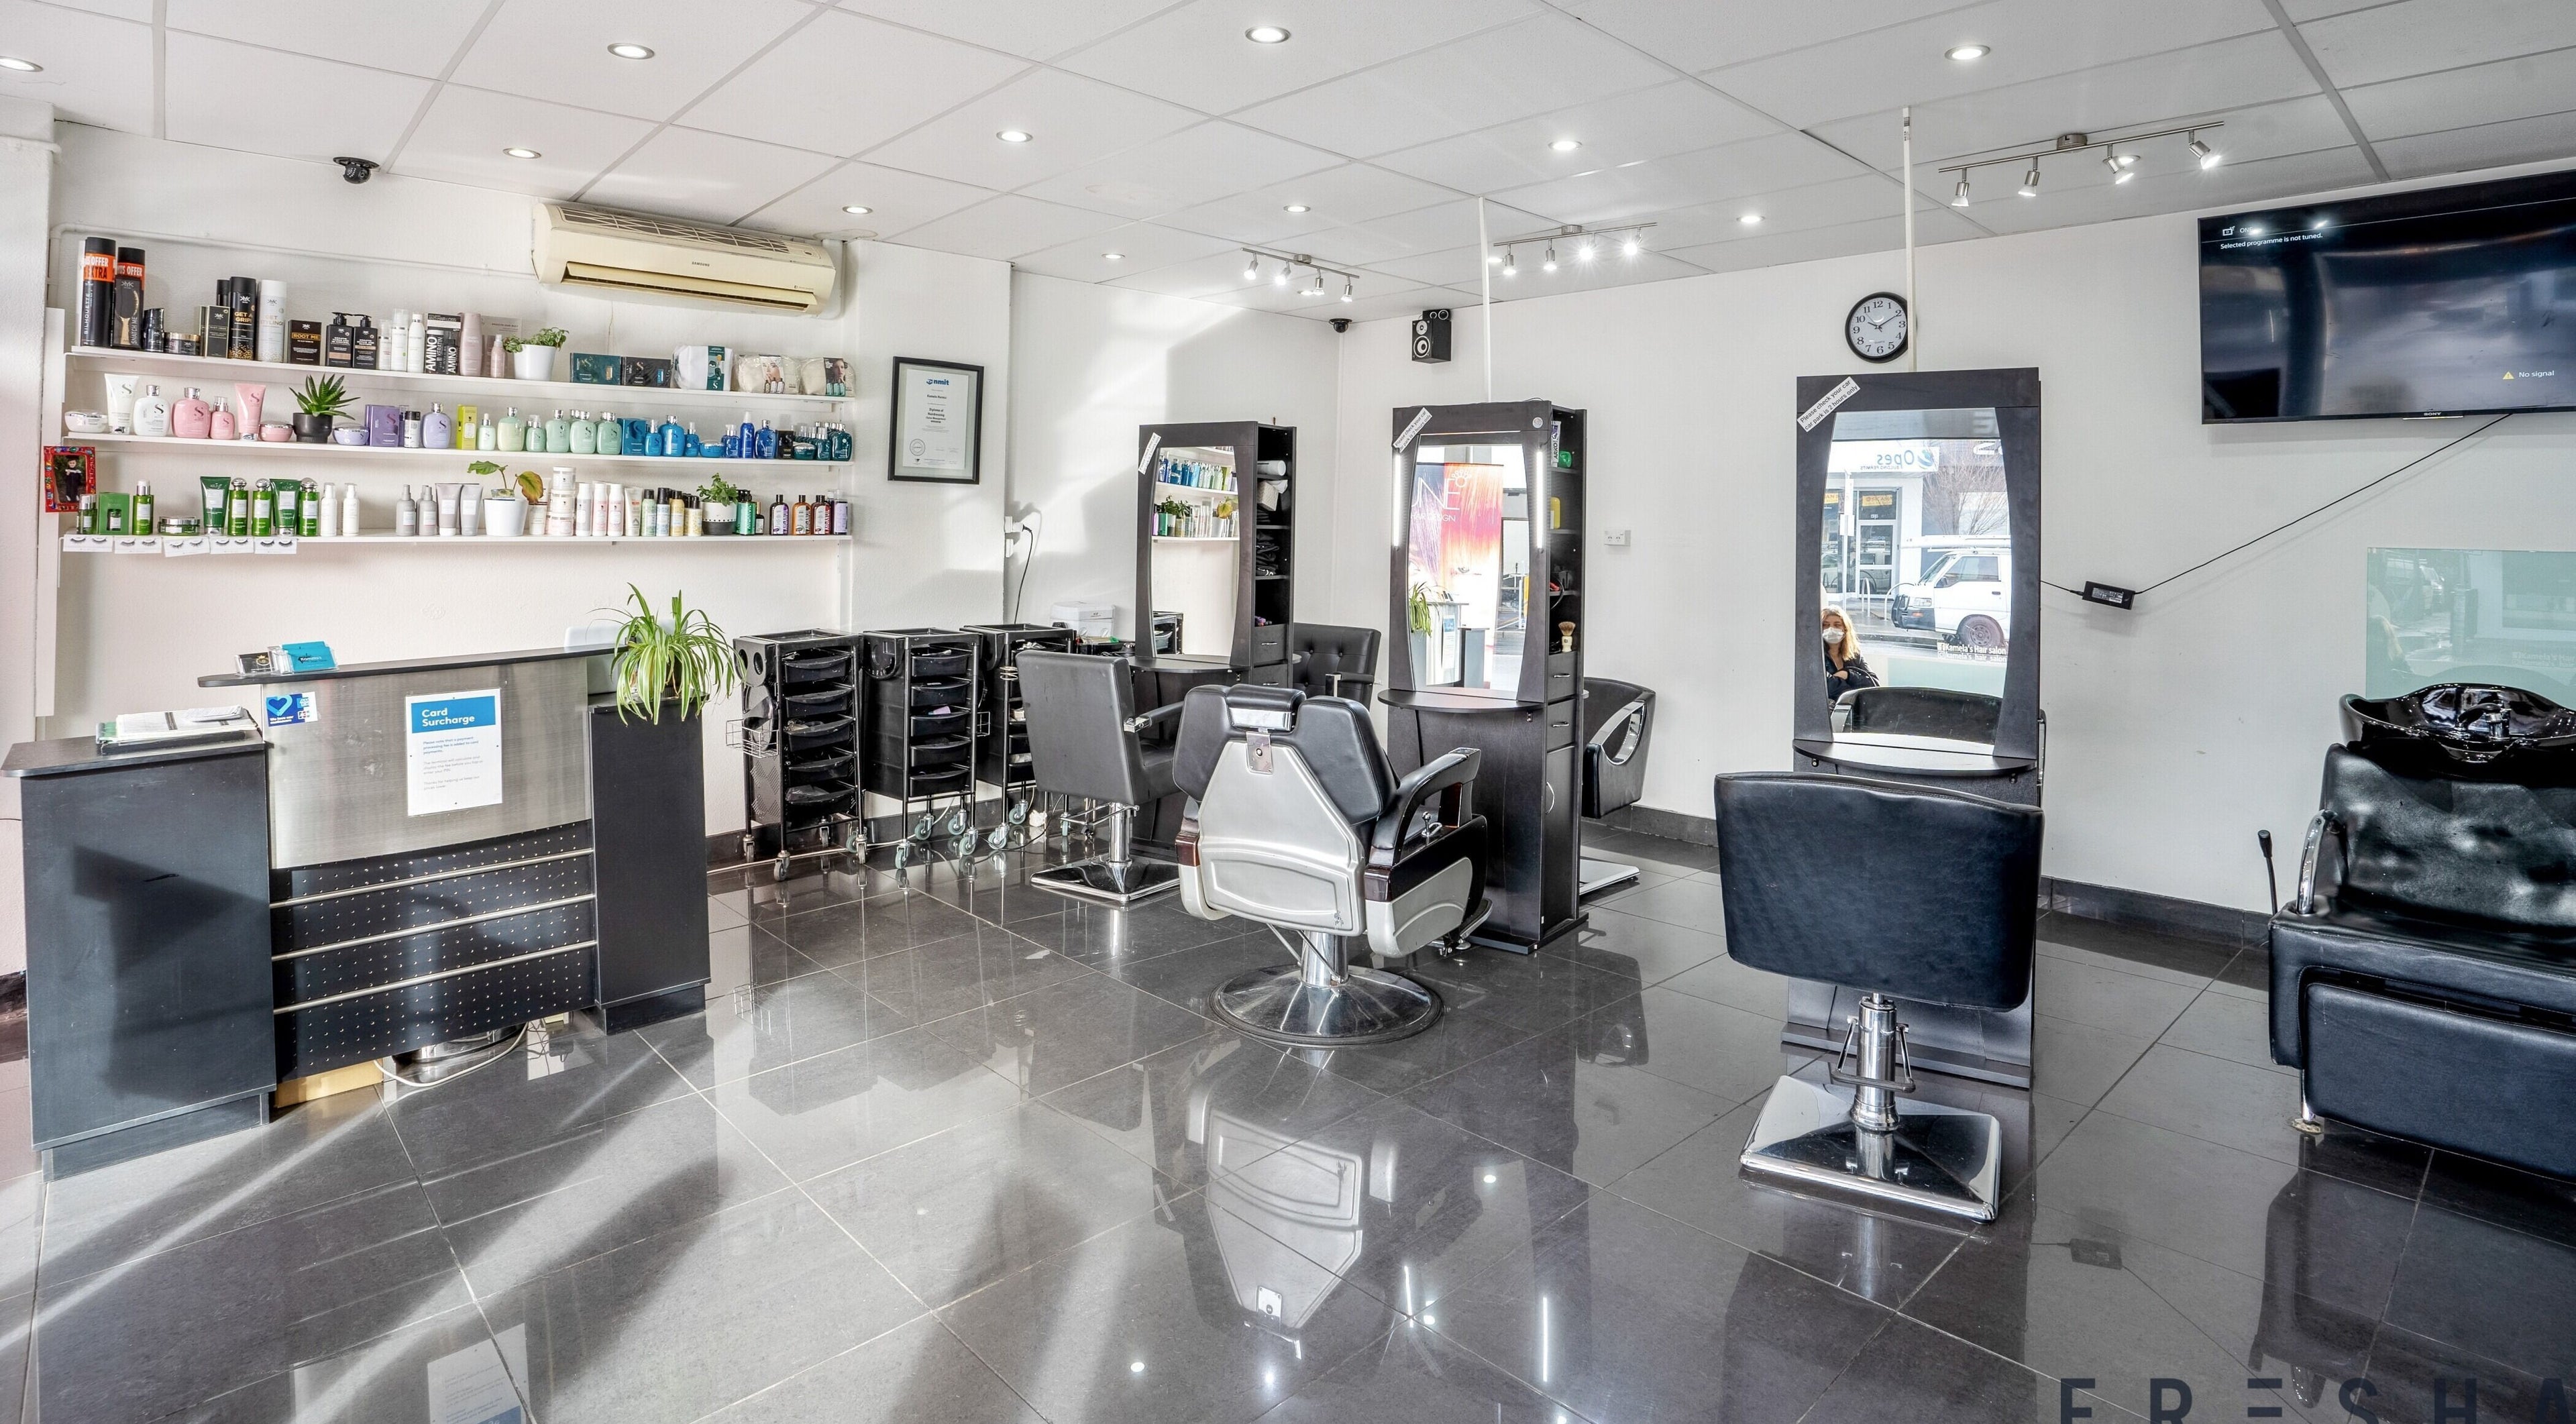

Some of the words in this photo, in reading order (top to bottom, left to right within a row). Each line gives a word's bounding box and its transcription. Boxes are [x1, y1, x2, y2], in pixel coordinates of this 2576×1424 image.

[2220, 241, 2246, 250] Selected
[2247, 237, 2283, 248] programme
[91, 257, 109, 268] OFFER
[127, 266, 143, 277] OFFER
[1857, 337, 1864, 345] 8
[1888, 341, 1894, 349] 5
[1865, 344, 1871, 352] 7
[1876, 345, 1884, 353] 6
[425, 336, 437, 372] AMINO
[447, 346, 457, 374] AMINO
[2531, 370, 2555, 378] signal
[1800, 408, 1817, 423] Please
[1817, 396, 1831, 410] check
[1831, 387, 1842, 398] your
[1842, 380, 1851, 389] car
[1805, 422, 1813, 430] car
[1813, 413, 1824, 424] park
[1832, 394, 1847, 407] hours
[1847, 385, 1858, 395] only
[1429, 514, 1456, 522] DESIGN
[1945, 643, 1973, 653] Kamela's
[1974, 645, 1988, 653] Hair
[1988, 646, 2006, 655] salon
[421, 708, 447, 718] Card
[422, 716, 475, 726] Surcharge
